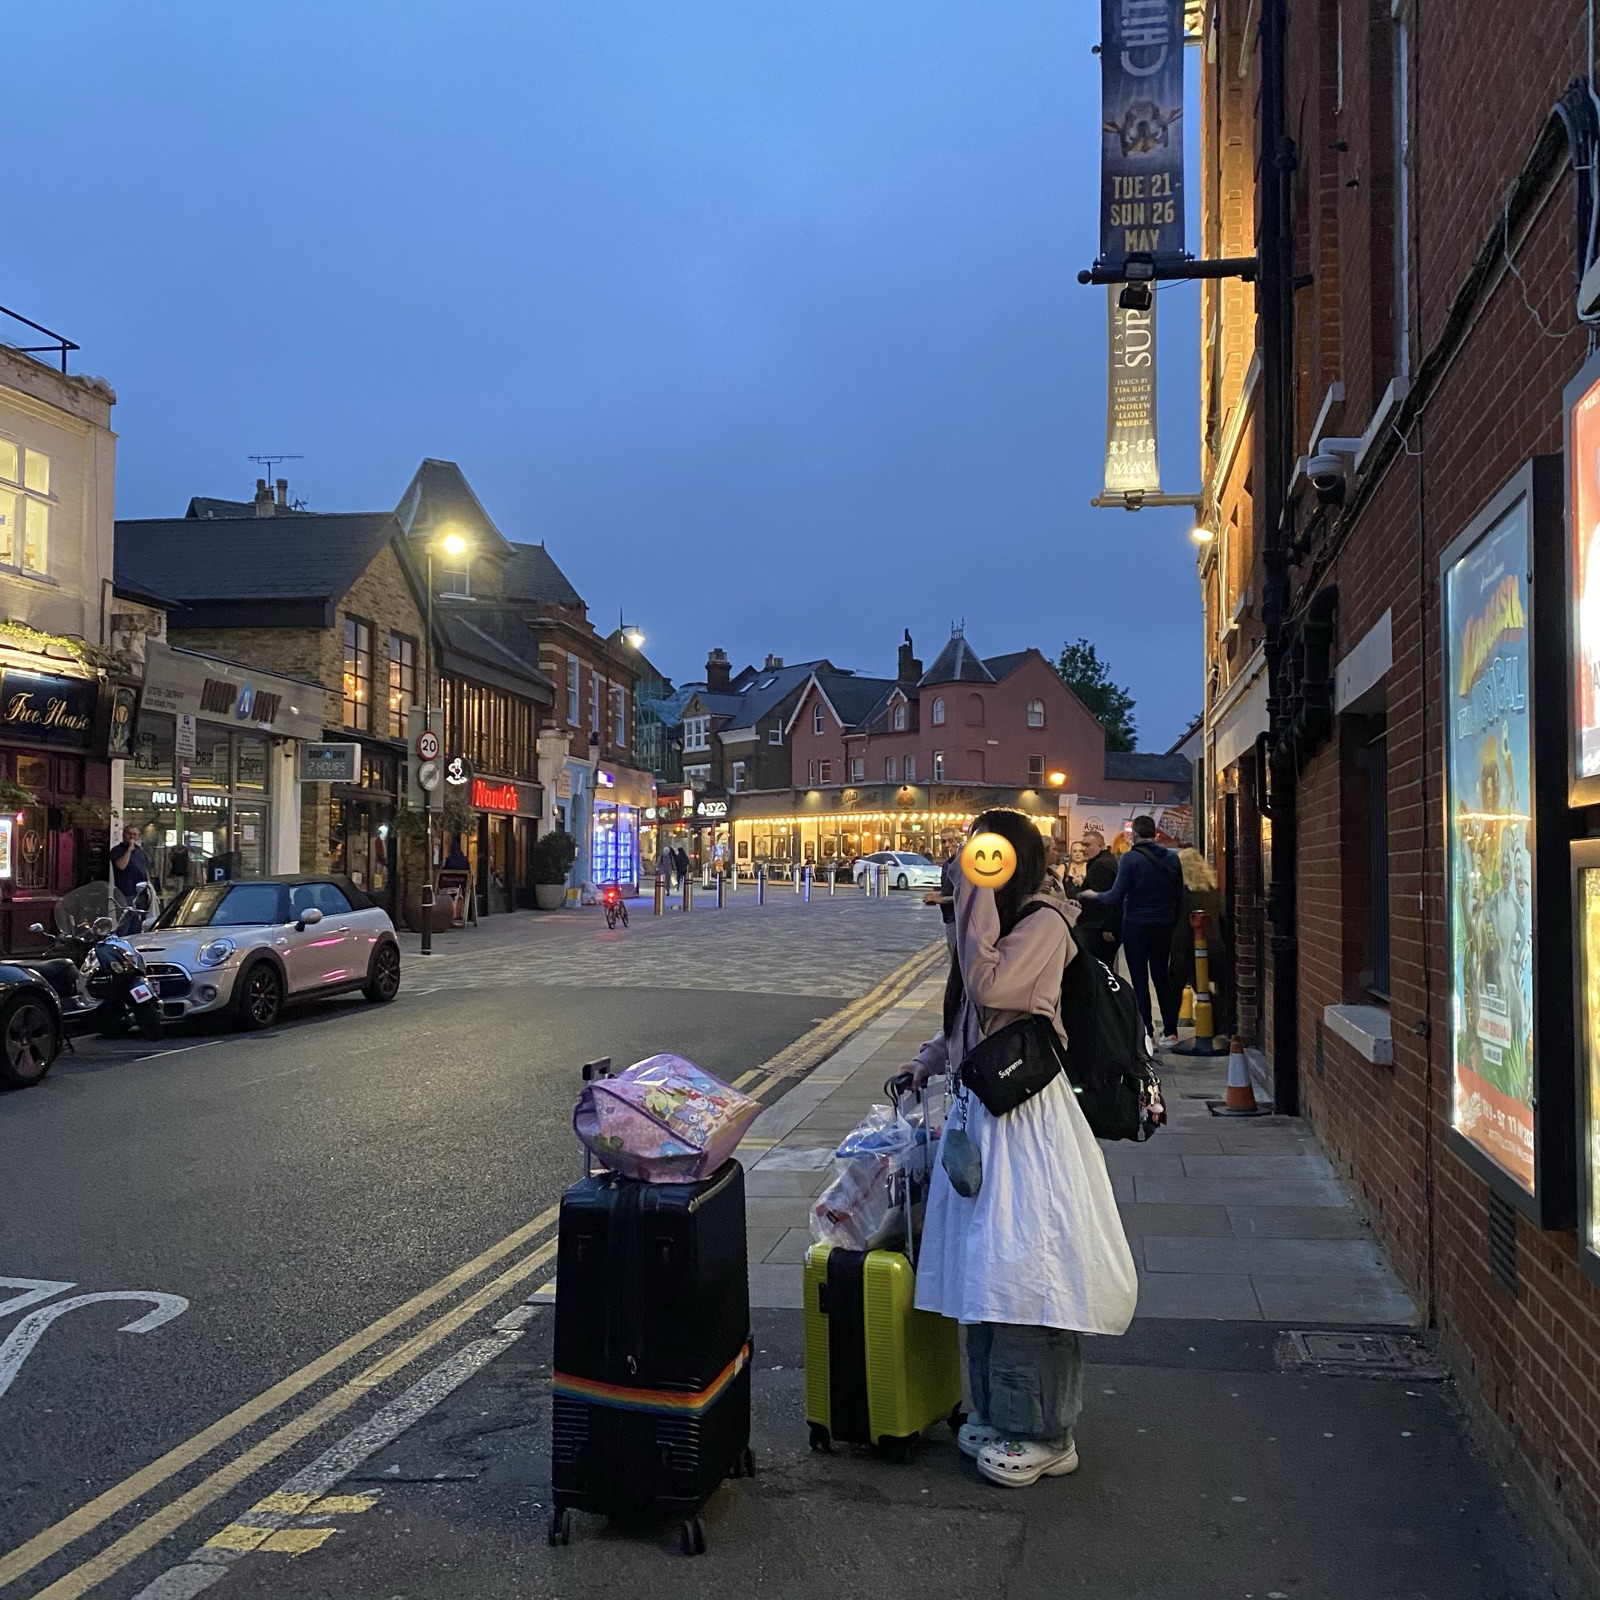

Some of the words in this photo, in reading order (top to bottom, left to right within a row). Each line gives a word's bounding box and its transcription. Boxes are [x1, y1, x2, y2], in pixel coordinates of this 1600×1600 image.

[1113, 176, 1144, 199] TUE
[1151, 172, 1172, 196] 21
[1110, 204, 1145, 226] SUN
[1152, 200, 1174, 224] 26
[1124, 229, 1160, 252] MAY
[1114, 386, 1130, 394] TIM
[1132, 384, 1152, 392] RICE
[1114, 402, 1151, 411] ANDREW
[1119, 411, 1147, 419] LLOYD
[1115, 419, 1151, 427] WEBBER
[200, 678, 237, 714] DRIP
[251, 690, 283, 723] DRY
[4, 693, 40, 724] Free
[40, 697, 90, 730] House
[422, 739, 436, 752] 20
[308, 762, 315, 772] 2
[317, 762, 346, 772] HOURS
[474, 780, 519, 811] Nando's
[214, 868, 224, 881] P
[134, 988, 149, 1000] L
